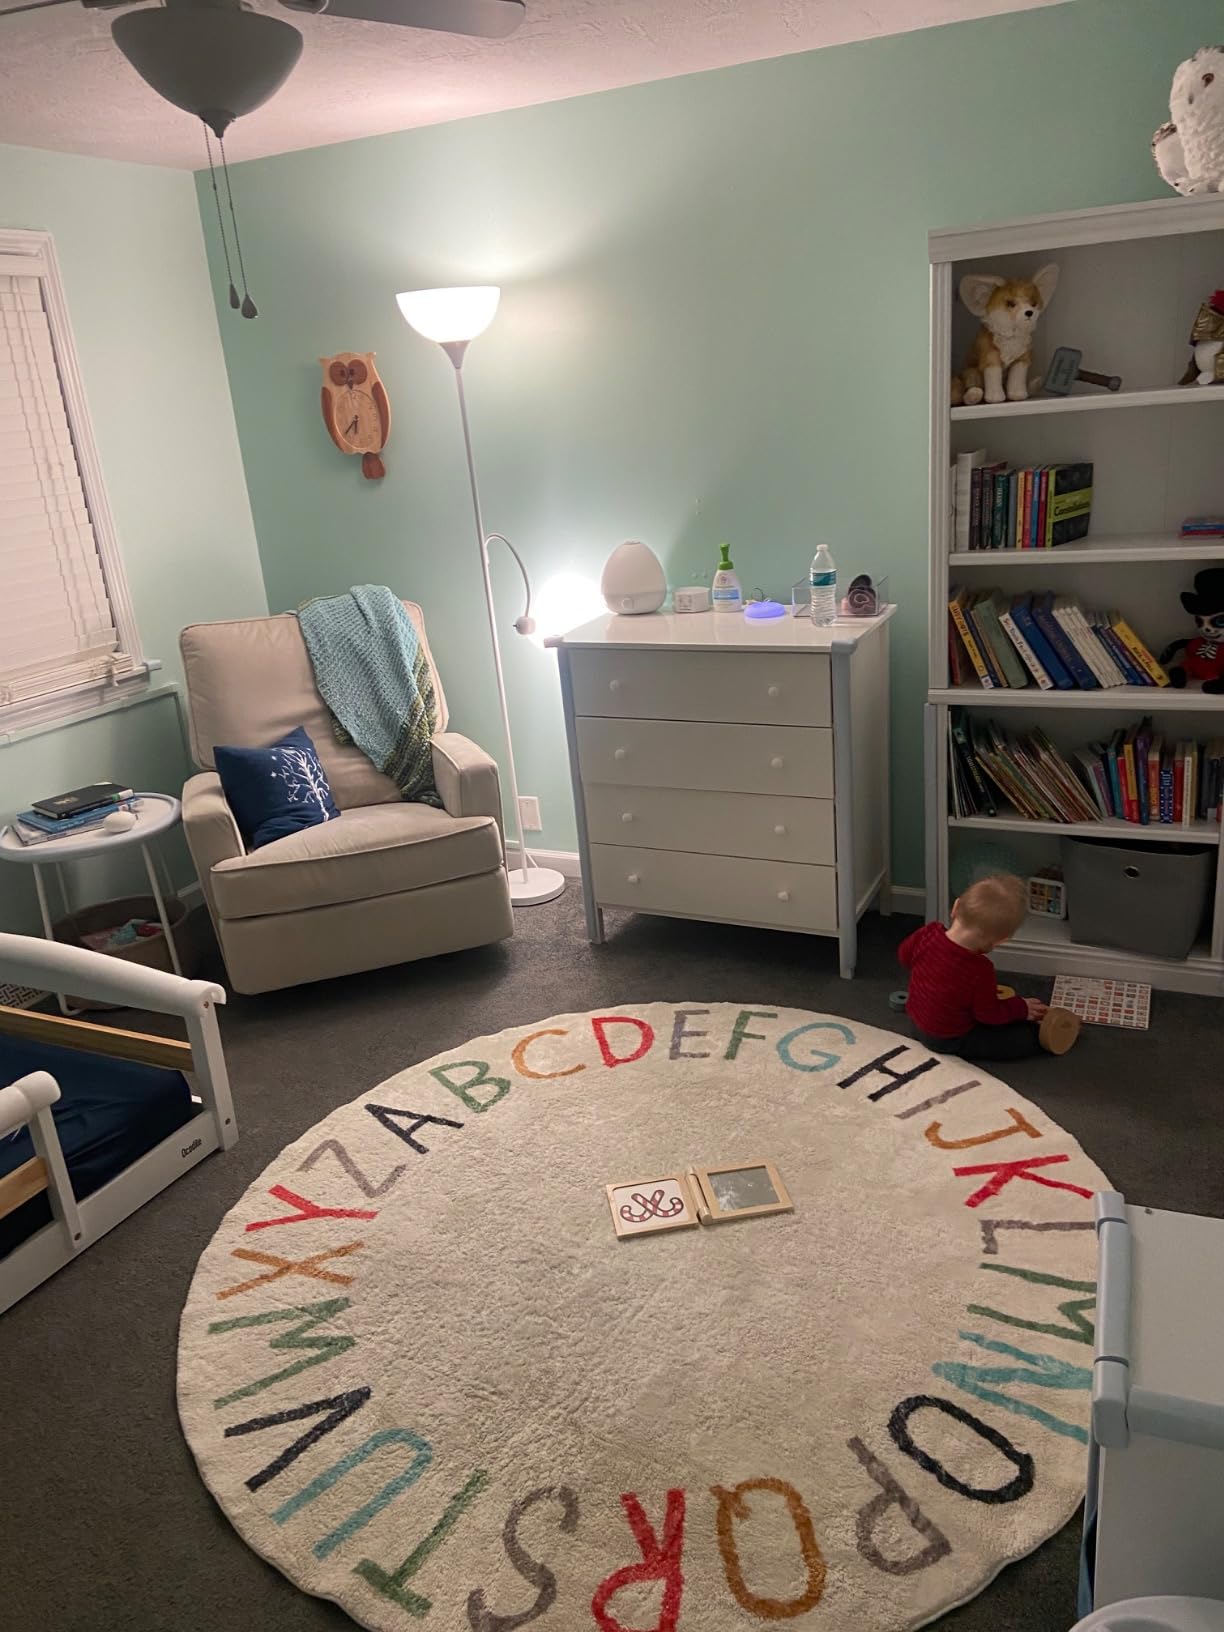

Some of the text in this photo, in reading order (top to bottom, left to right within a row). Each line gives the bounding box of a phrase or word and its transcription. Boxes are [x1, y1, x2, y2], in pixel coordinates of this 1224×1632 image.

[207, 1009, 1097, 1632] A B C D E F G H I J K L M N O P Q R S T U V W X Y Z
